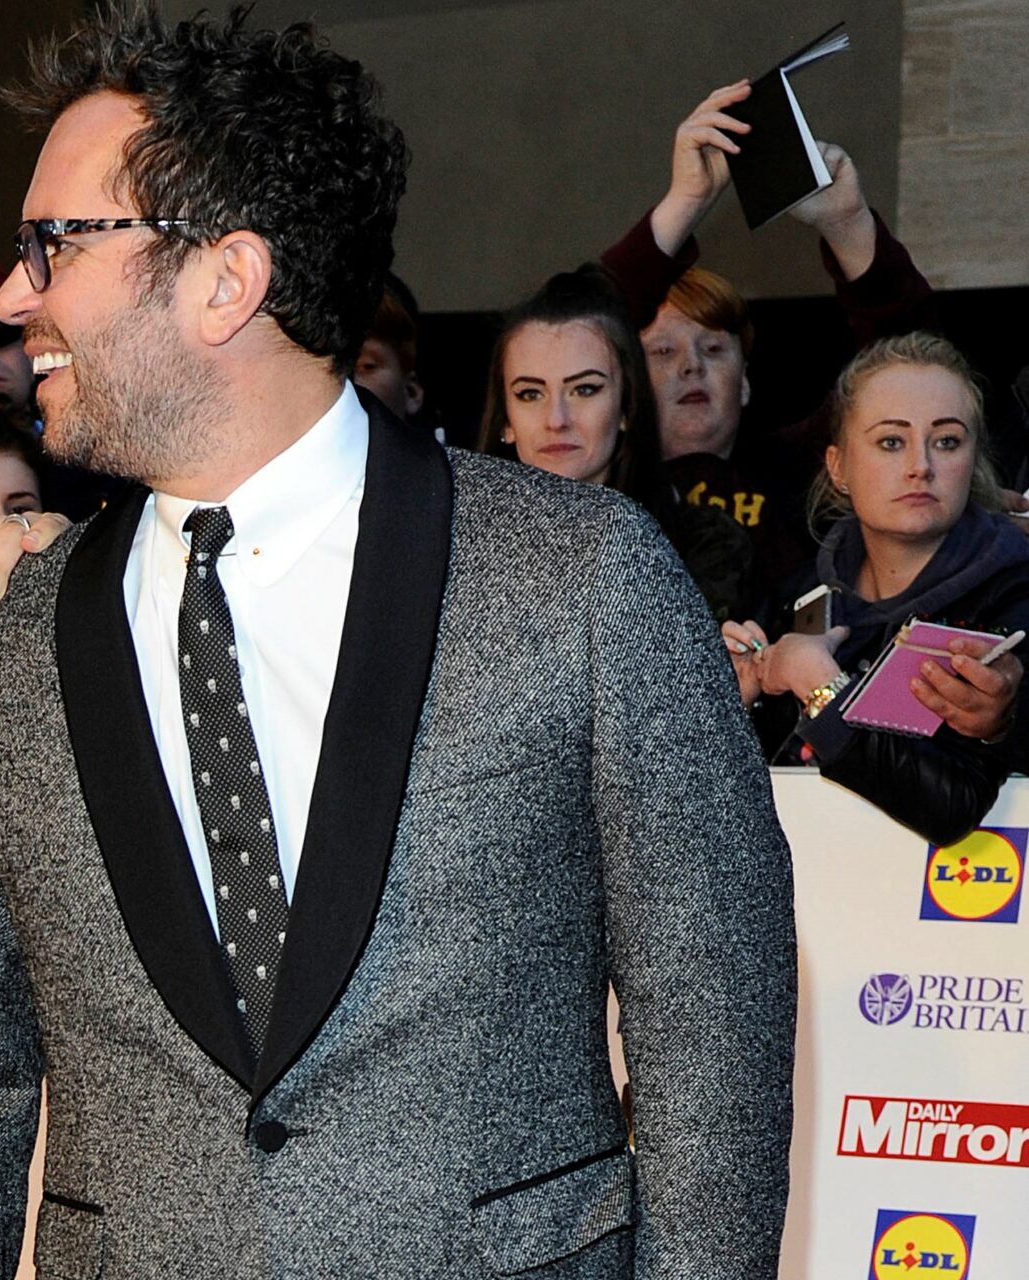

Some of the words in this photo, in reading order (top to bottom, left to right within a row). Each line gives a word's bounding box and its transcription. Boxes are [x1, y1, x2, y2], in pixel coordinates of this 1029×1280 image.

[916, 974, 1024, 1005] PRIDE
[912, 1003, 1029, 1034] BRITAI
[908, 1102, 964, 1122] DAILY
[842, 1099, 1029, 1163] Mirror
